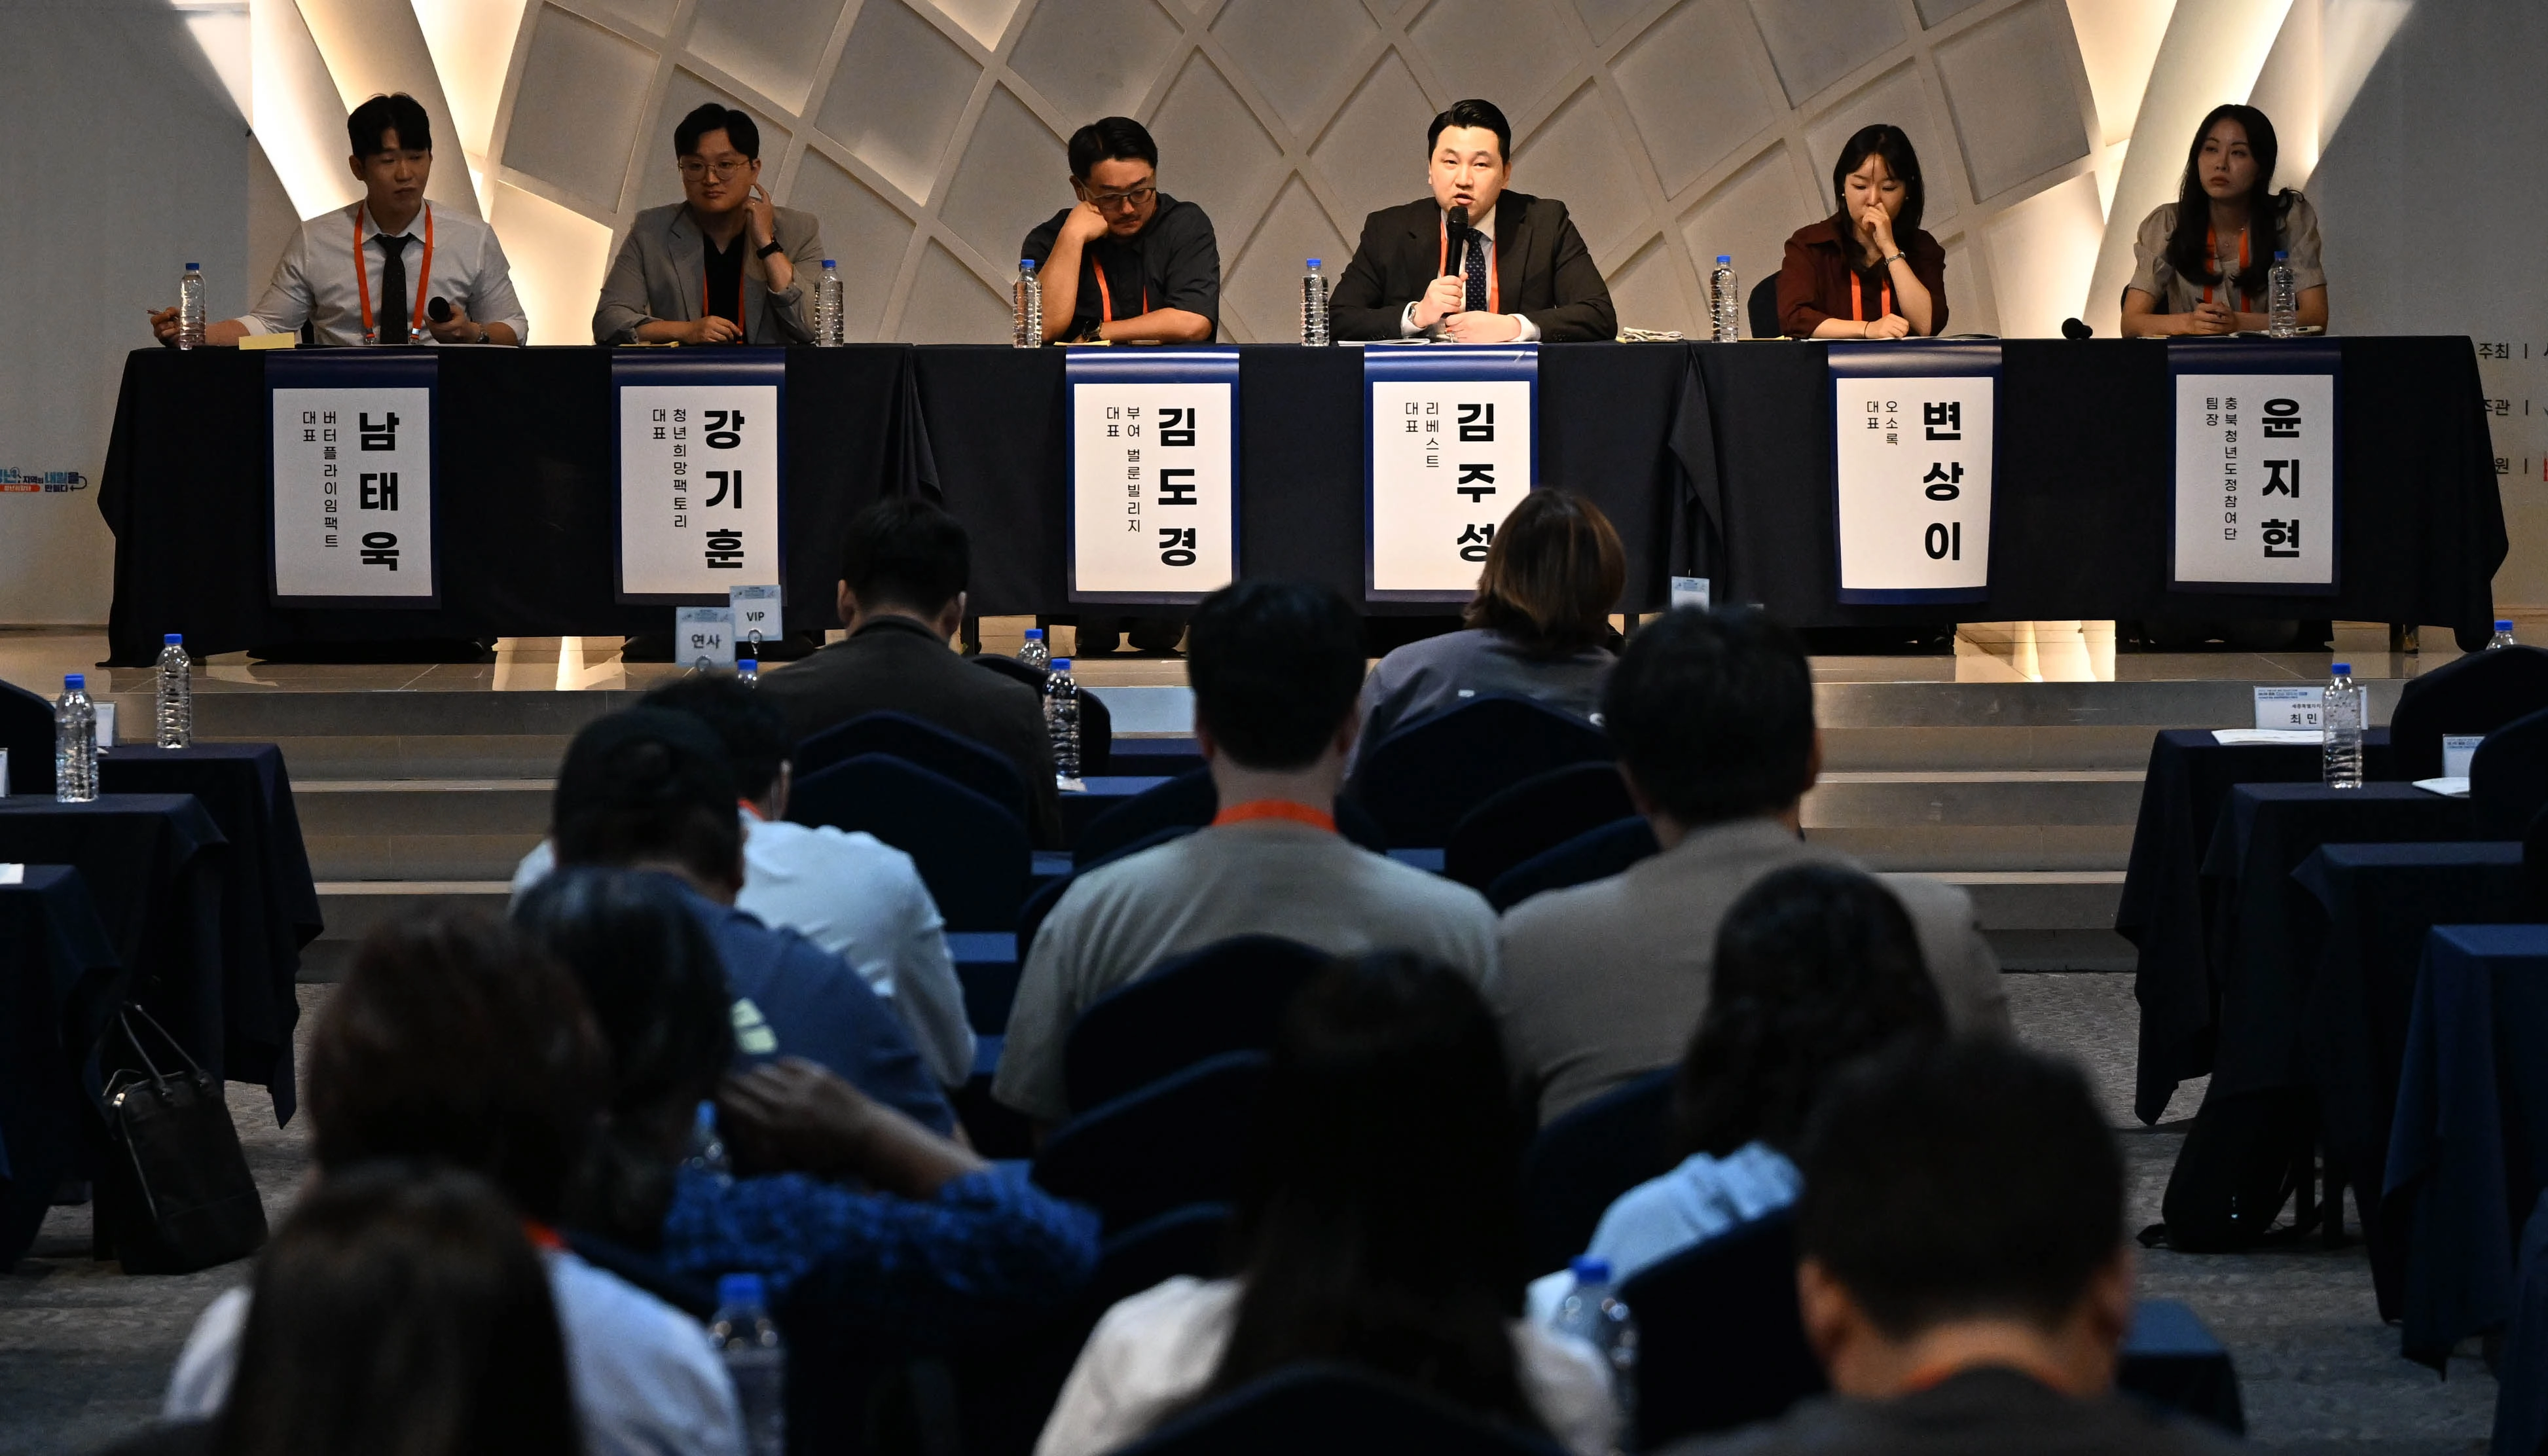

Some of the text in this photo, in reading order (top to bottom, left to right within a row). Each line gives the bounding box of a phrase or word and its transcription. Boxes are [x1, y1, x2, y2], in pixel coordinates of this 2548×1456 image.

[2478, 342, 2509, 359] 주최
[302, 410, 317, 442] 대표
[652, 409, 666, 440] 대표
[1106, 407, 1120, 437] 대표
[1405, 402, 1419, 433] 대표
[1426, 402, 1440, 468] 리베스트
[1866, 401, 1883, 429] 대표
[1885, 401, 1899, 446] 오소록
[2206, 397, 2219, 426] 팀장
[323, 410, 338, 548] 버터플라이임팩트
[359, 412, 400, 572] 남태욱
[673, 408, 687, 529] 청년희망팩토리
[704, 410, 745, 569] 강기훈
[1127, 407, 1140, 534] 부여 벌룬빌리지
[1157, 407, 1197, 567] 김도경
[1457, 403, 1496, 562] 김주성
[1923, 401, 1964, 561] 변상이
[2224, 397, 2238, 541] 충북청년도정참여단
[2261, 398, 2302, 558] 윤지현
[2495, 458, 2509, 475] 원
[691, 633, 721, 649] 연사
[746, 611, 765, 622] VIP
